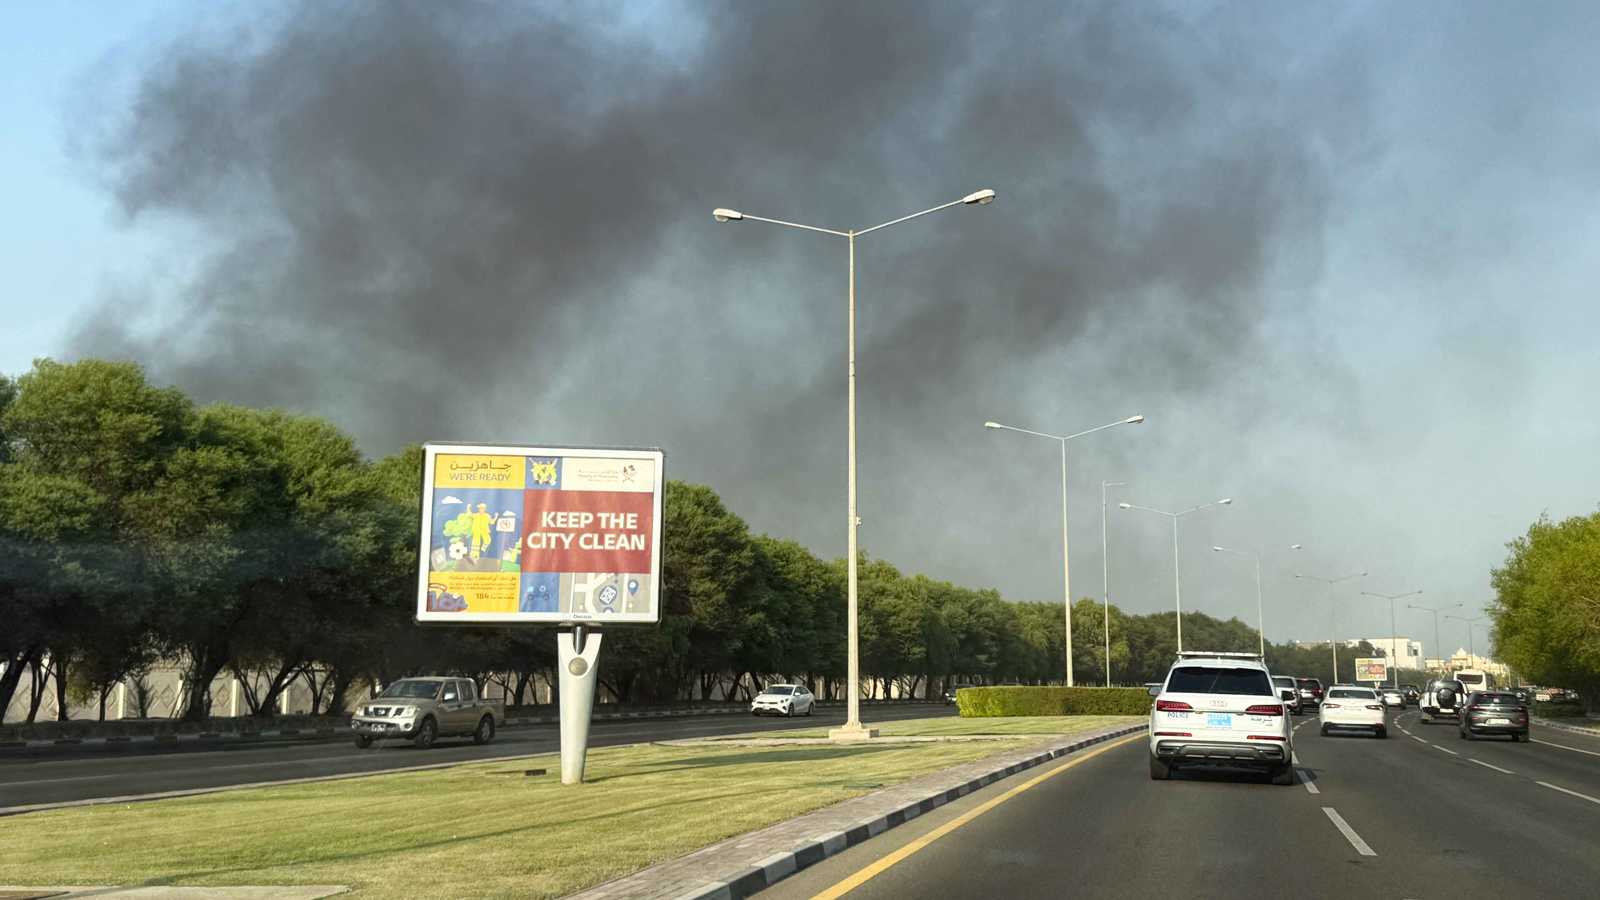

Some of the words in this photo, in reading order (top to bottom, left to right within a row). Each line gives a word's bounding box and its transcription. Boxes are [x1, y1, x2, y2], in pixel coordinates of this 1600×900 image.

[450, 459, 512, 472] جاهزين
[479, 472, 512, 481] READY
[542, 511, 593, 528] KEEP
[597, 512, 638, 529] THE
[527, 532, 575, 549] CITY
[579, 533, 645, 550] CLEAN
